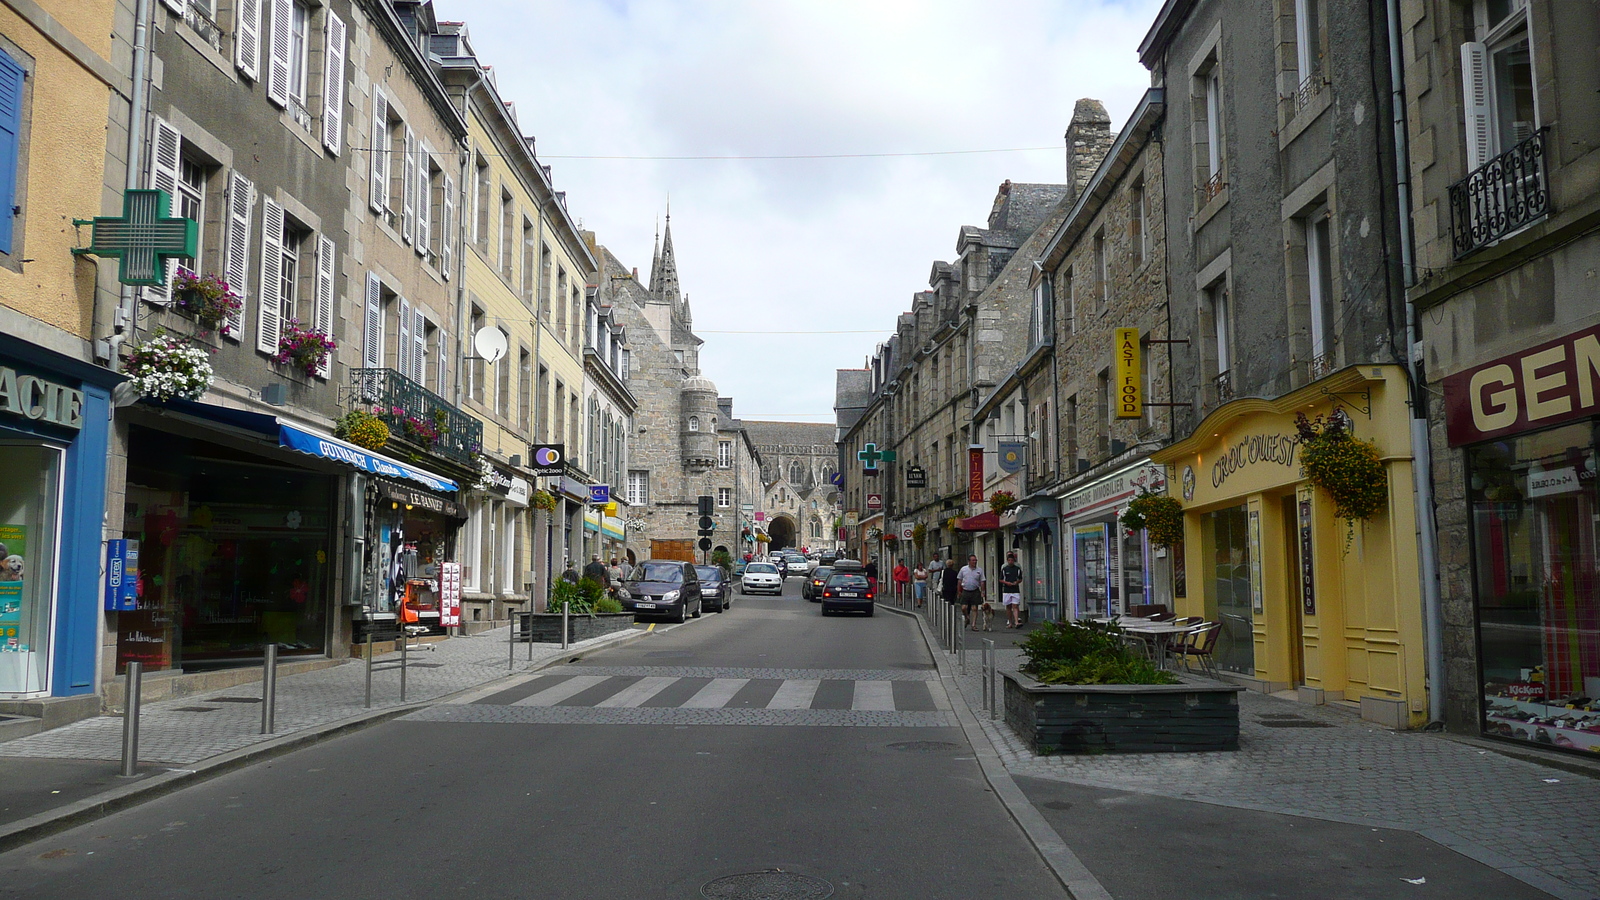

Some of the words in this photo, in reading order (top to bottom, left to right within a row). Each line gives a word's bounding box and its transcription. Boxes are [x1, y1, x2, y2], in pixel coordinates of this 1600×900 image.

[319, 440, 368, 469] GUIVARCH
[534, 468, 548, 476] Optic
[971, 452, 982, 500] PIZZA
[1068, 490, 1092, 511] BRETAGNE
[1093, 477, 1125, 501] IMMOBILIER
[112, 560, 122, 585] durex
